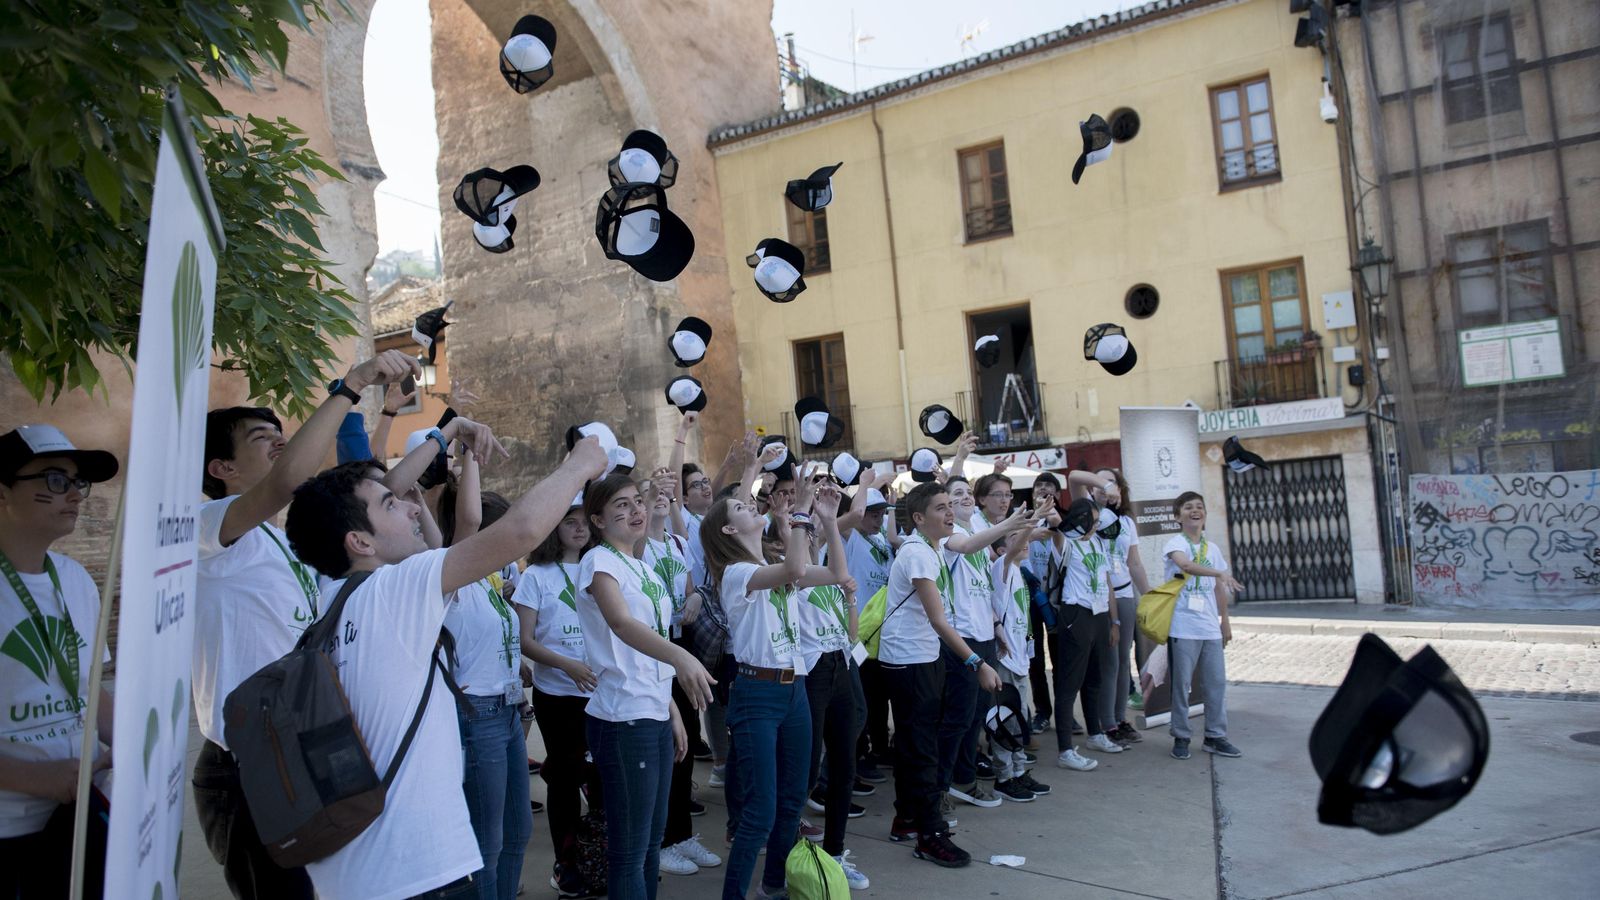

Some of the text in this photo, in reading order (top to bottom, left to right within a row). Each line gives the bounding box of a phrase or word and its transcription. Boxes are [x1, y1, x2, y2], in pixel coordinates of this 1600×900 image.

[1200, 408, 1260, 432] JOYERIA
[1136, 513, 1168, 524] EDUCACIÓN
[344, 620, 358, 645] ti
